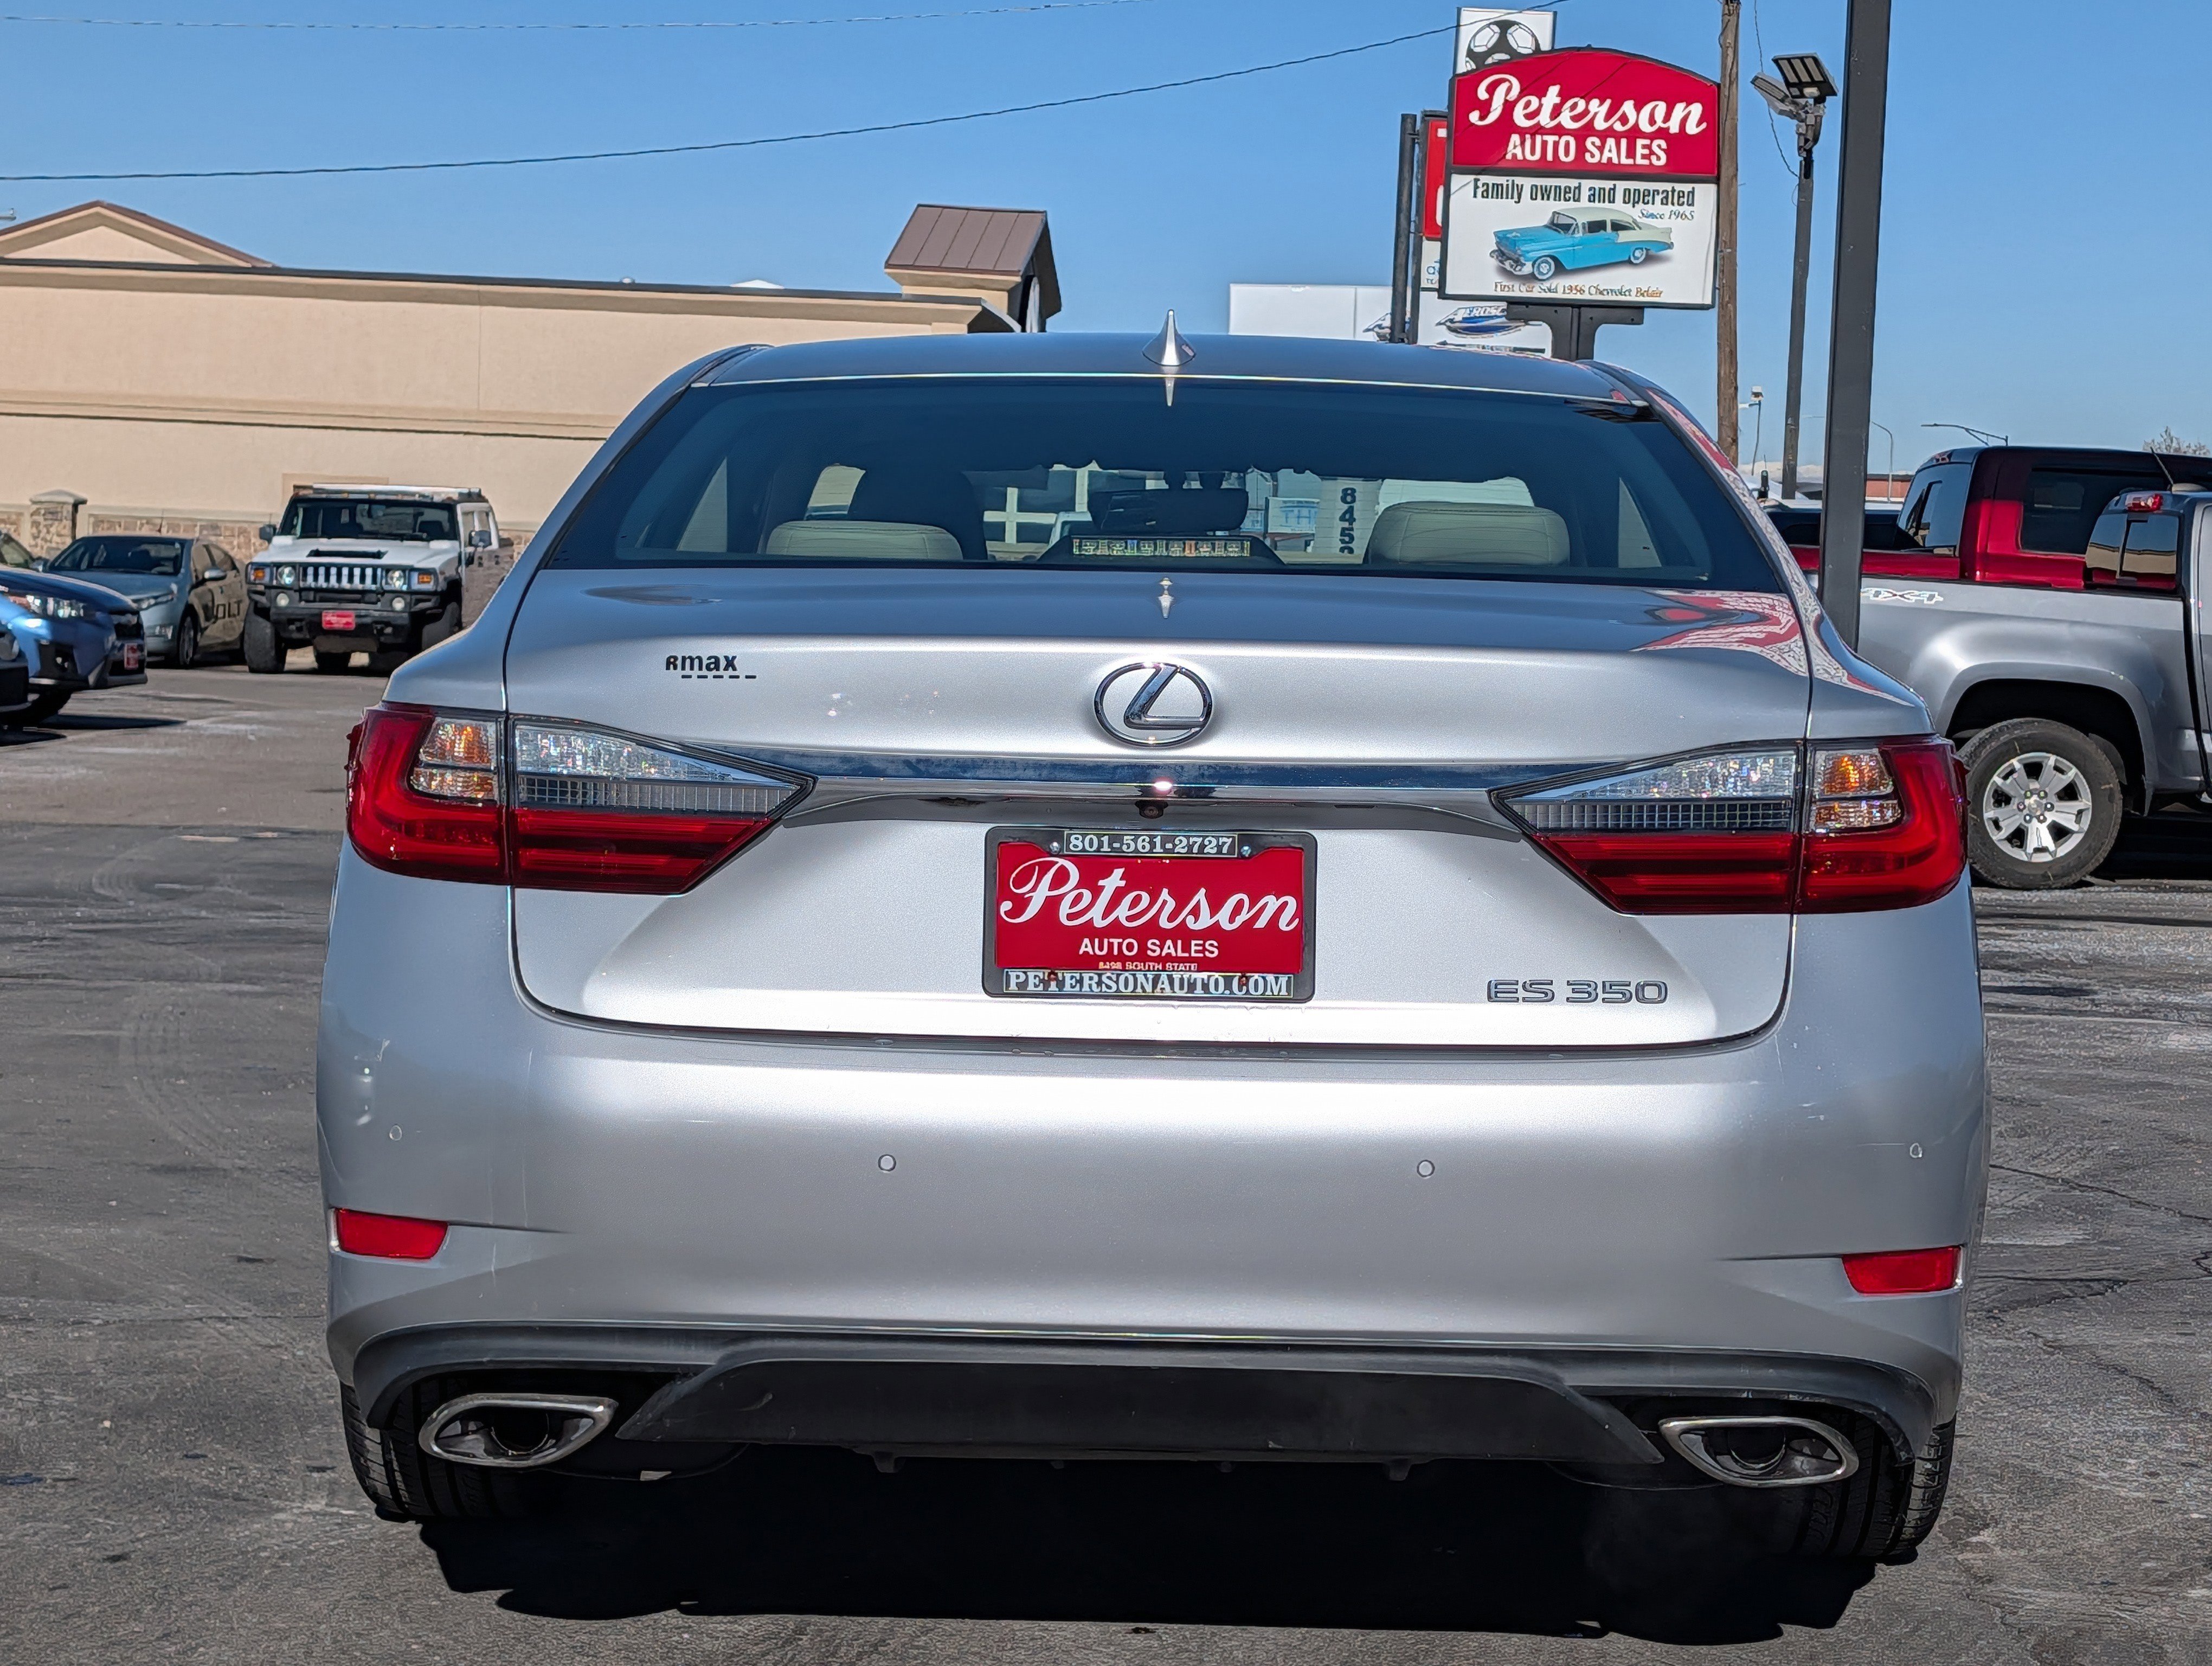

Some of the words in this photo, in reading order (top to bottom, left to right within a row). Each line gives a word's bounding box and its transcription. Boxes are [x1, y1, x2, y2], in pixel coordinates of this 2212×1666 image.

[1469, 74, 1707, 136] Peterson
[1505, 133, 1576, 163] AUTO
[1584, 136, 1668, 166] SALES
[1472, 178, 1524, 204] Family
[1529, 182, 1581, 203] owned
[1587, 183, 1617, 204] and
[1622, 185, 1695, 208] operated
[1668, 209, 1695, 221] 1965
[1494, 281, 1515, 292] First
[1069, 834, 1234, 855] 801-561-2727
[1000, 856, 1300, 932] Peterson
[1078, 938, 1139, 956] AUTO
[1146, 939, 1219, 958] SALES
[1125, 962, 1162, 971] SOUTH
[1166, 963, 1198, 971] STATE
[1008, 969, 1289, 998] PETERSONAUTO.COM
[1487, 979, 1555, 1003] ES
[1566, 979, 1668, 1004] 350
